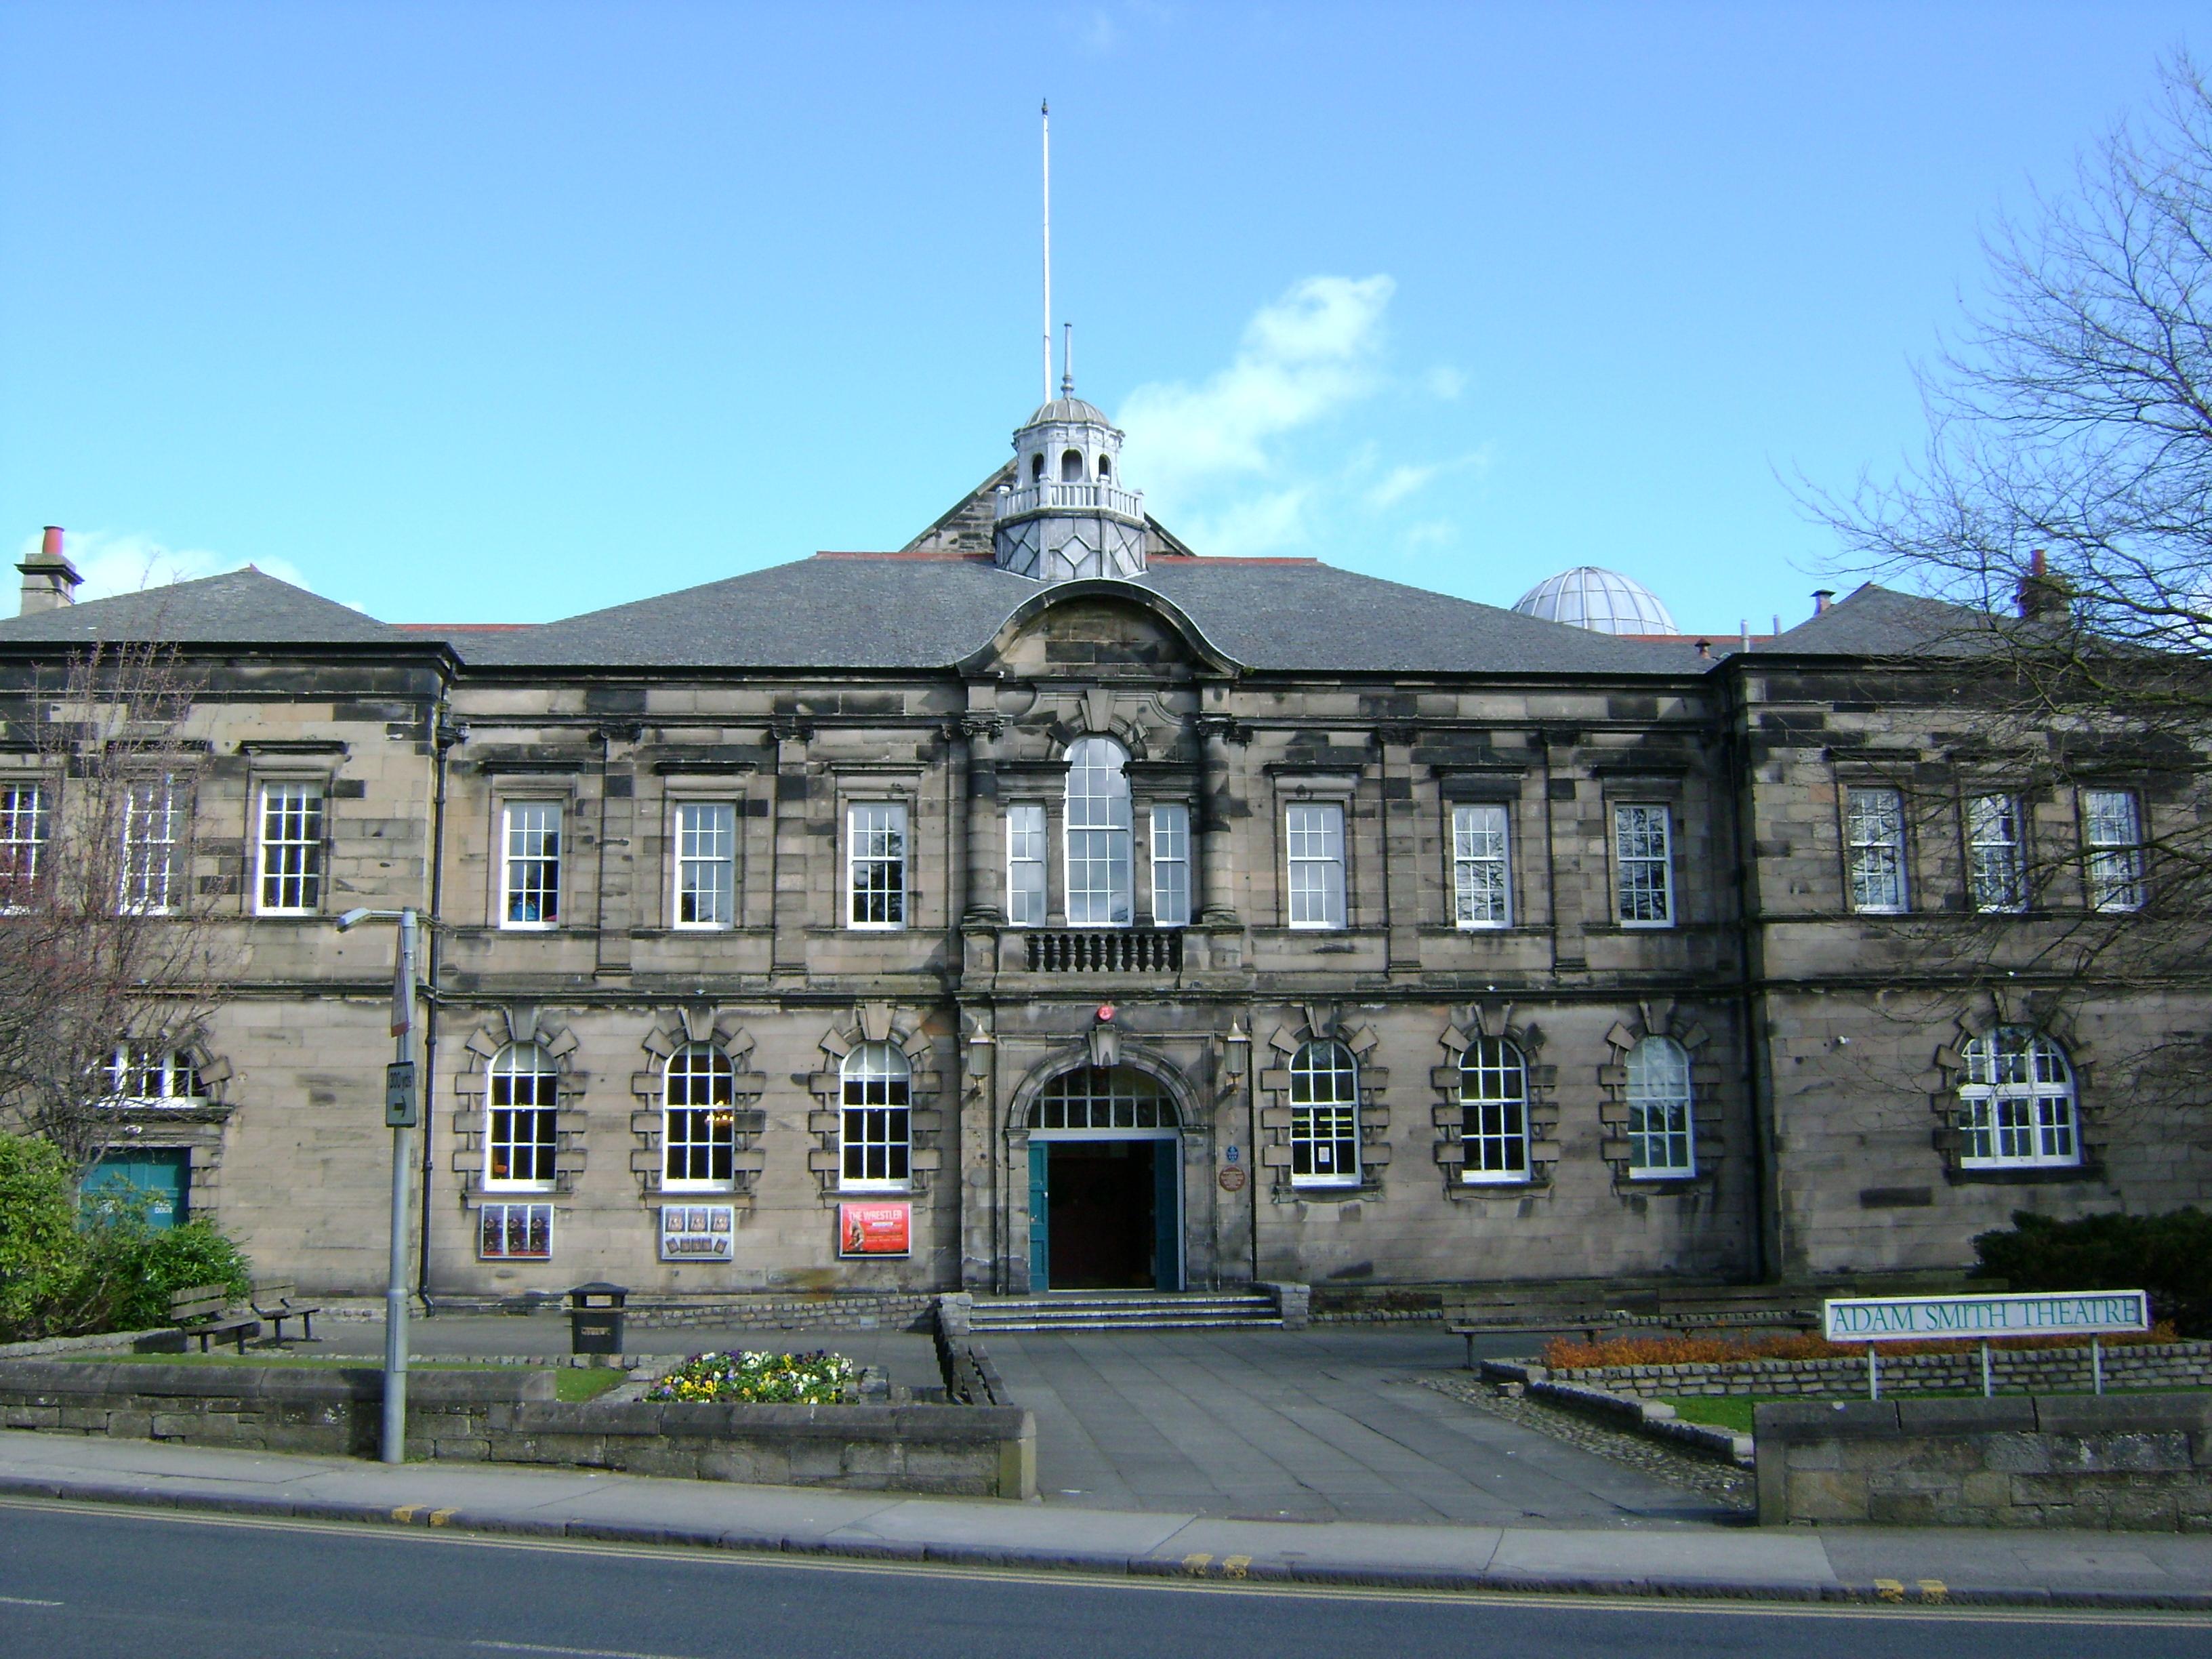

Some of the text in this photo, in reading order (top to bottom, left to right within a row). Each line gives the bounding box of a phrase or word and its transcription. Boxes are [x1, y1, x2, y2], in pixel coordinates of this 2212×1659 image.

[848, 1210, 903, 1221] THE WRESTLER
[1832, 1298, 2137, 1332] ADAM SMITH THEATRE
